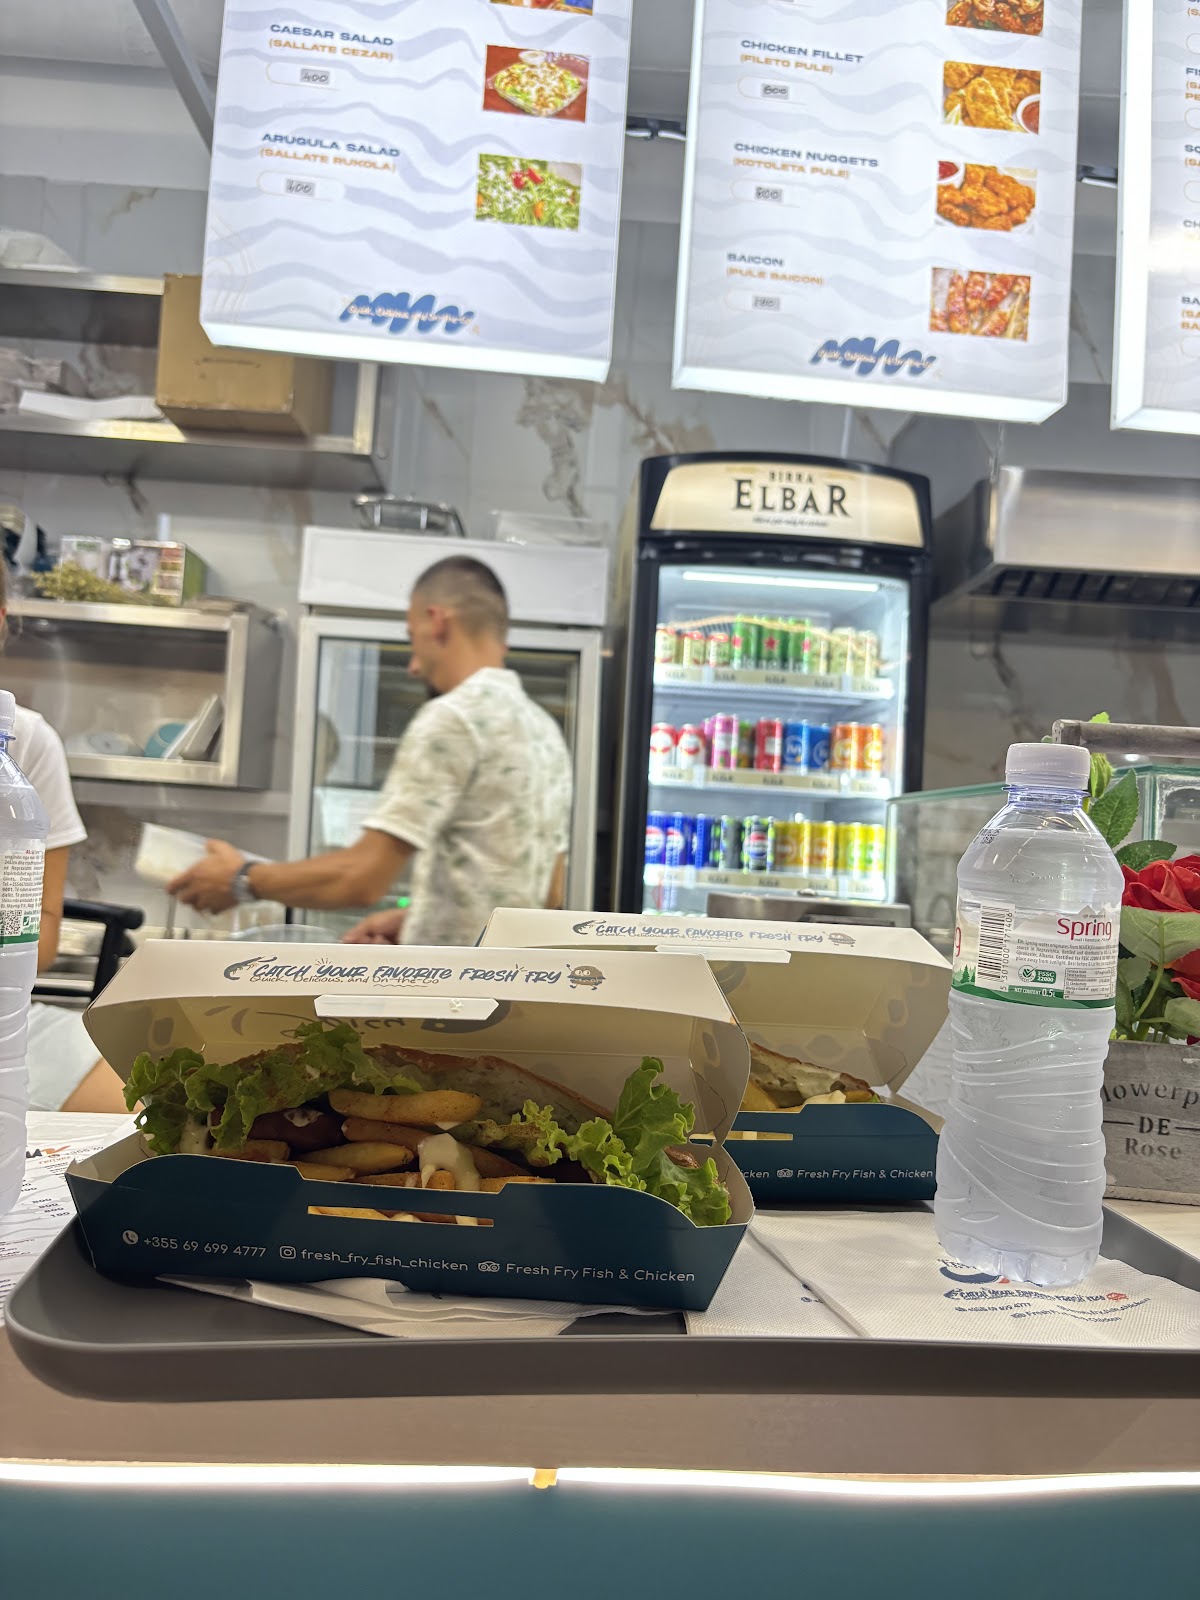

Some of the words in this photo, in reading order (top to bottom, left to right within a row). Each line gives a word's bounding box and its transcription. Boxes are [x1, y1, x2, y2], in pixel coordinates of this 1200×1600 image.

[270, 24, 334, 39] CAESAR
[340, 32, 394, 46] SALAD
[269, 38, 337, 54] (SALLATE
[341, 47, 394, 62] CEZAR)
[741, 40, 808, 56] CHICKEN
[812, 49, 864, 63] FILLET
[740, 53, 791, 68] (FILETO
[794, 61, 833, 74] PULE)
[262, 133, 339, 150] ARUGULA
[346, 143, 400, 157] SALAD
[734, 143, 801, 159] CHICKEN
[806, 151, 878, 167] NUGGETS
[260, 148, 329, 163] (SALLATE
[333, 156, 396, 173] RUKOLA)
[810, 166, 849, 180] PULE)
[727, 253, 784, 266] BAICON
[769, 471, 814, 484] BIRRA
[733, 478, 851, 519] ELBAR
[595, 924, 637, 934] CATCH
[642, 926, 680, 935] YOUR
[685, 927, 744, 938] FAVORITE
[749, 931, 792, 941] FRESH
[797, 934, 823, 942] FRY
[1056, 917, 1112, 941] Spring
[253, 964, 312, 978] CATCH
[314, 964, 368, 978] YOUR
[372, 965, 452, 980] FAVORITE
[459, 968, 519, 982] FRESH
[524, 970, 562, 984] FRY
[1138, 1116, 1171, 1136] DE
[1125, 1137, 1182, 1160] Rose
[797, 1168, 830, 1179] Fresh
[831, 1169, 851, 1180] Fry
[852, 1169, 876, 1179] Fish
[878, 1169, 887, 1179] &
[890, 1168, 933, 1179] Chicken
[143, 1236, 178, 1250] +355
[183, 1240, 199, 1251] 69
[203, 1242, 229, 1254] 699
[233, 1245, 267, 1258] 4777
[301, 1248, 469, 1271] fresh_fry_fish_chicken
[506, 1263, 550, 1276] Fresh
[553, 1265, 579, 1279] Fry
[582, 1267, 613, 1279] Fish
[618, 1268, 629, 1280] &
[633, 1269, 695, 1282] Chicken
